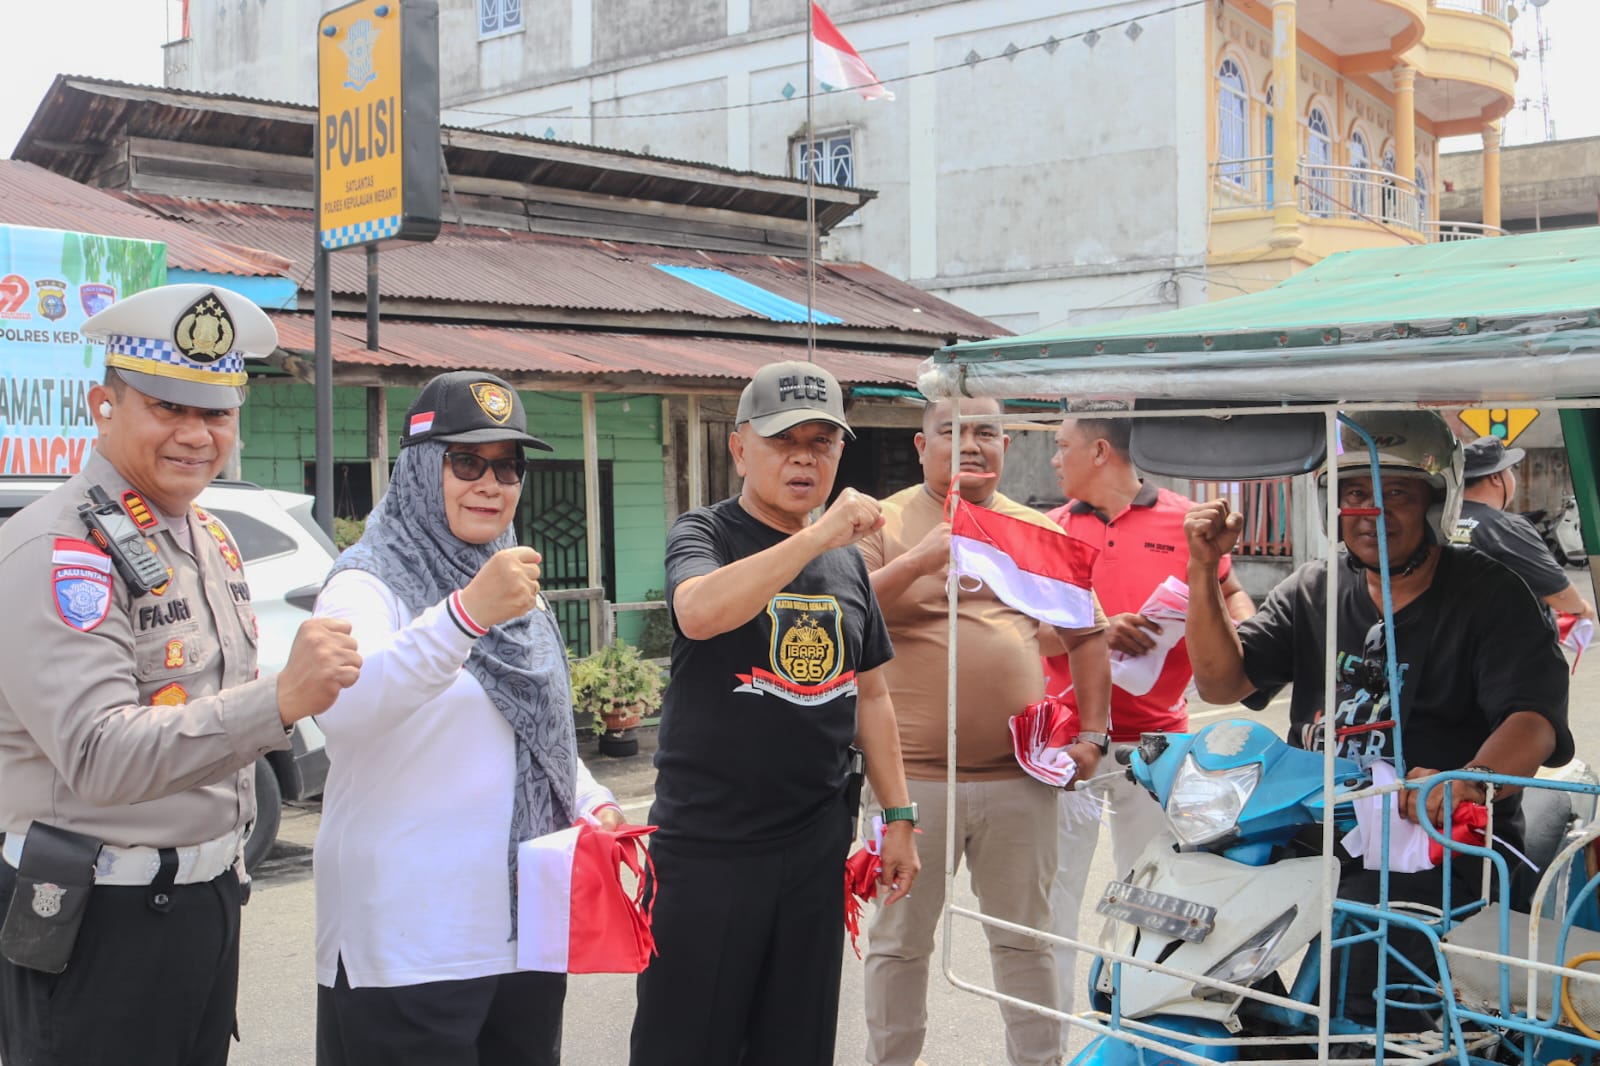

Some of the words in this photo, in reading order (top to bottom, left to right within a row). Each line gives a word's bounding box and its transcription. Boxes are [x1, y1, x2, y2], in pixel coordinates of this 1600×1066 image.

[326, 96, 395, 171] POLISI
[346, 176, 374, 192] SATLANTAS
[325, 199, 343, 214] POLRES
[343, 193, 373, 210] KEPULAUAN
[374, 187, 397, 203] MERANTI
[56, 568, 80, 578] LALU
[80, 569, 109, 584] LINTAS
[139, 598, 191, 630] FAJRI
[792, 659, 823, 678] 86
